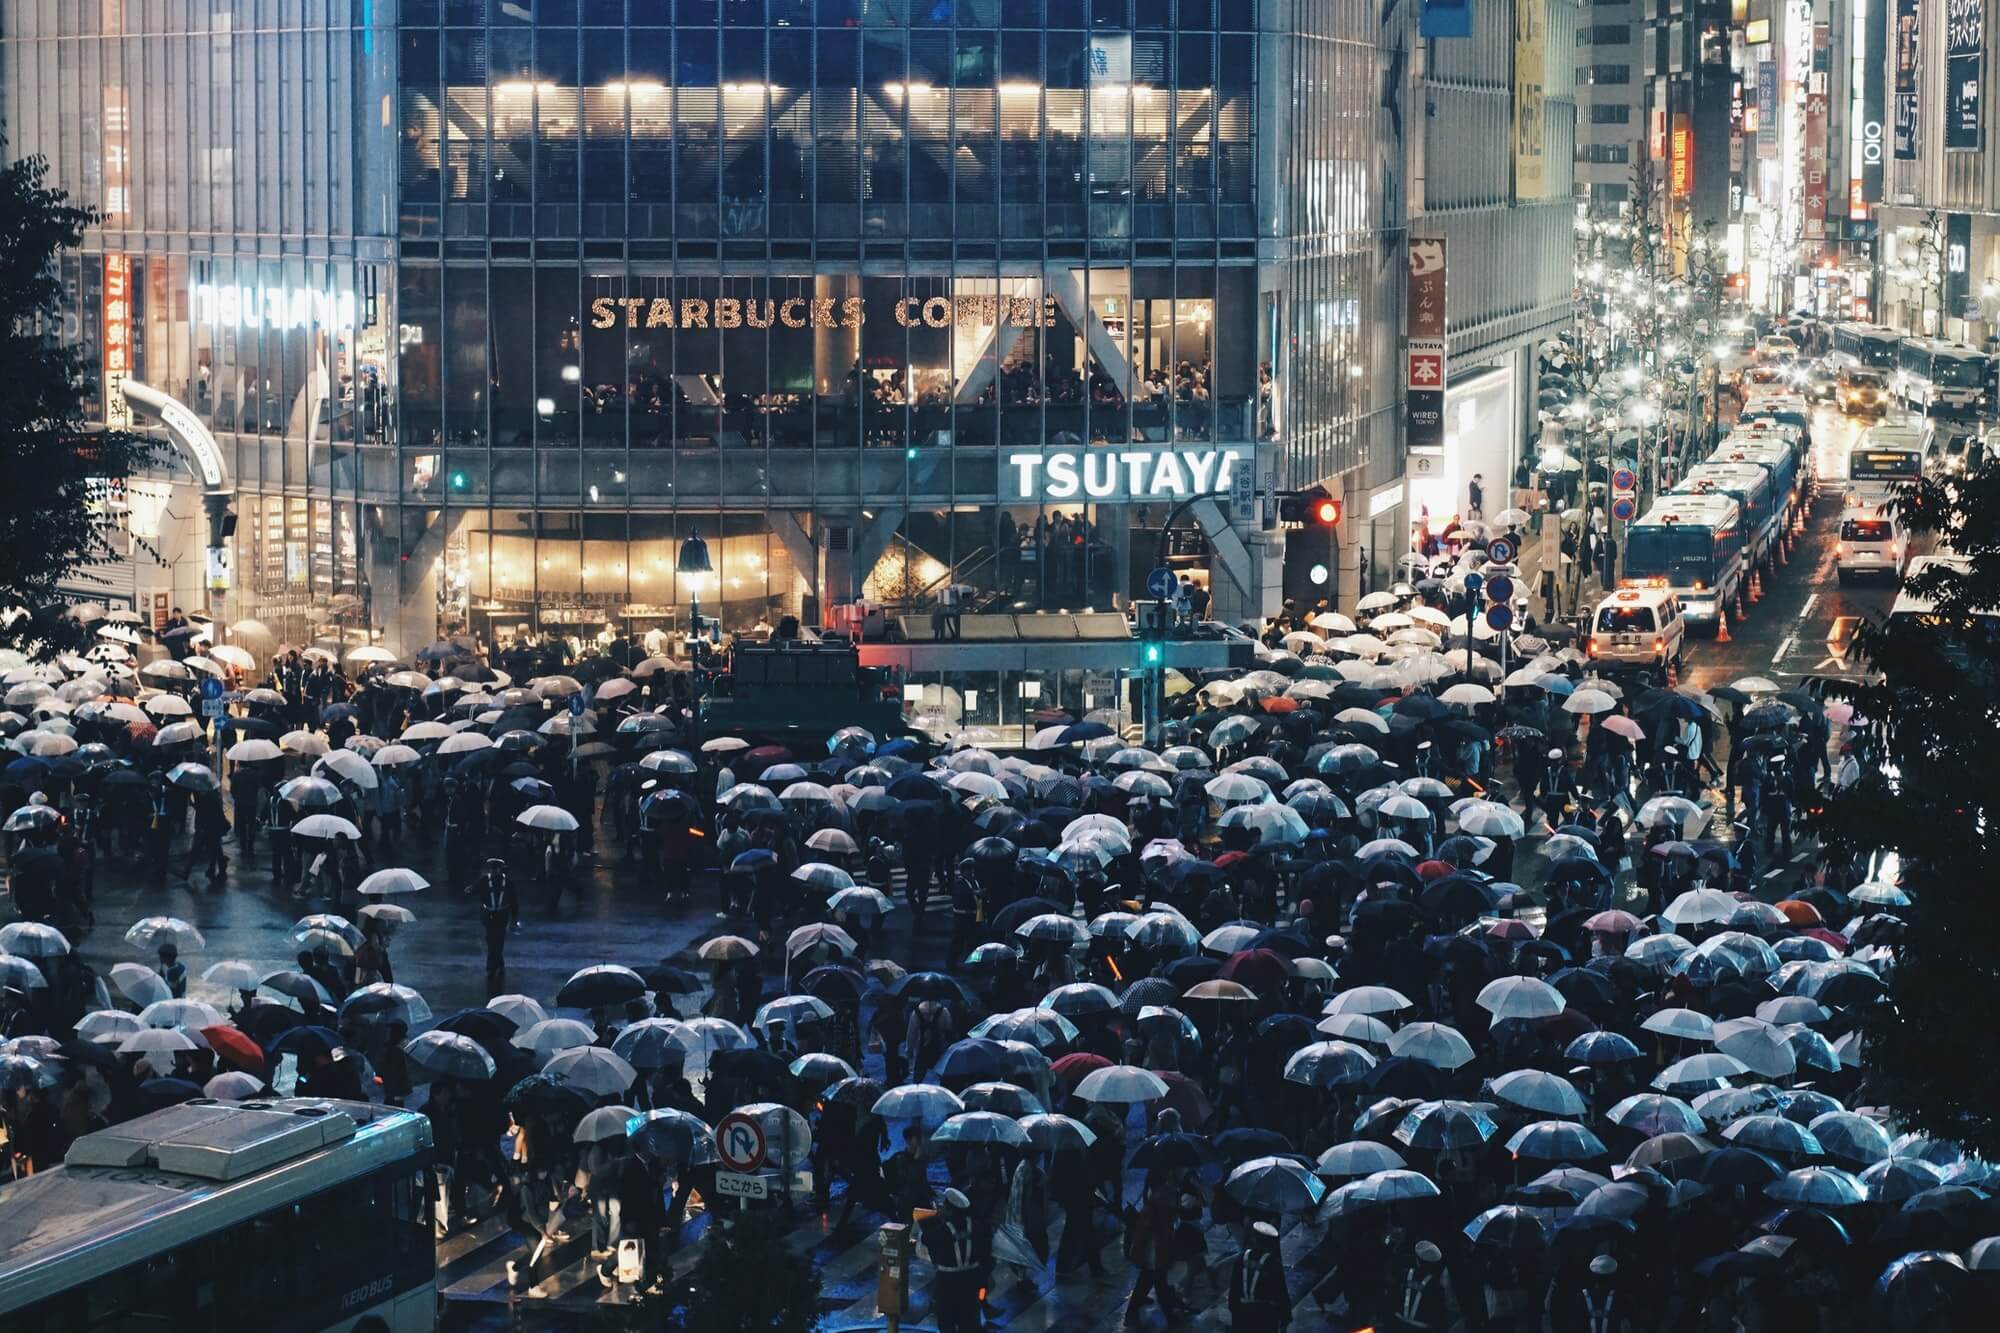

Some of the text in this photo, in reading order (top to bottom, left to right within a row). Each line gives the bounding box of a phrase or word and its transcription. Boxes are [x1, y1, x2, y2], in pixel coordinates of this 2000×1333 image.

[590, 297, 1057, 329] STARBUCKS COFFEE
[1414, 358, 1438, 383] 本
[1412, 411, 1438, 419] WIRED
[1010, 450, 1240, 497] TSUTAYA
[720, 1178, 763, 1195] ここから
[369, 1273, 393, 1297] BUS
